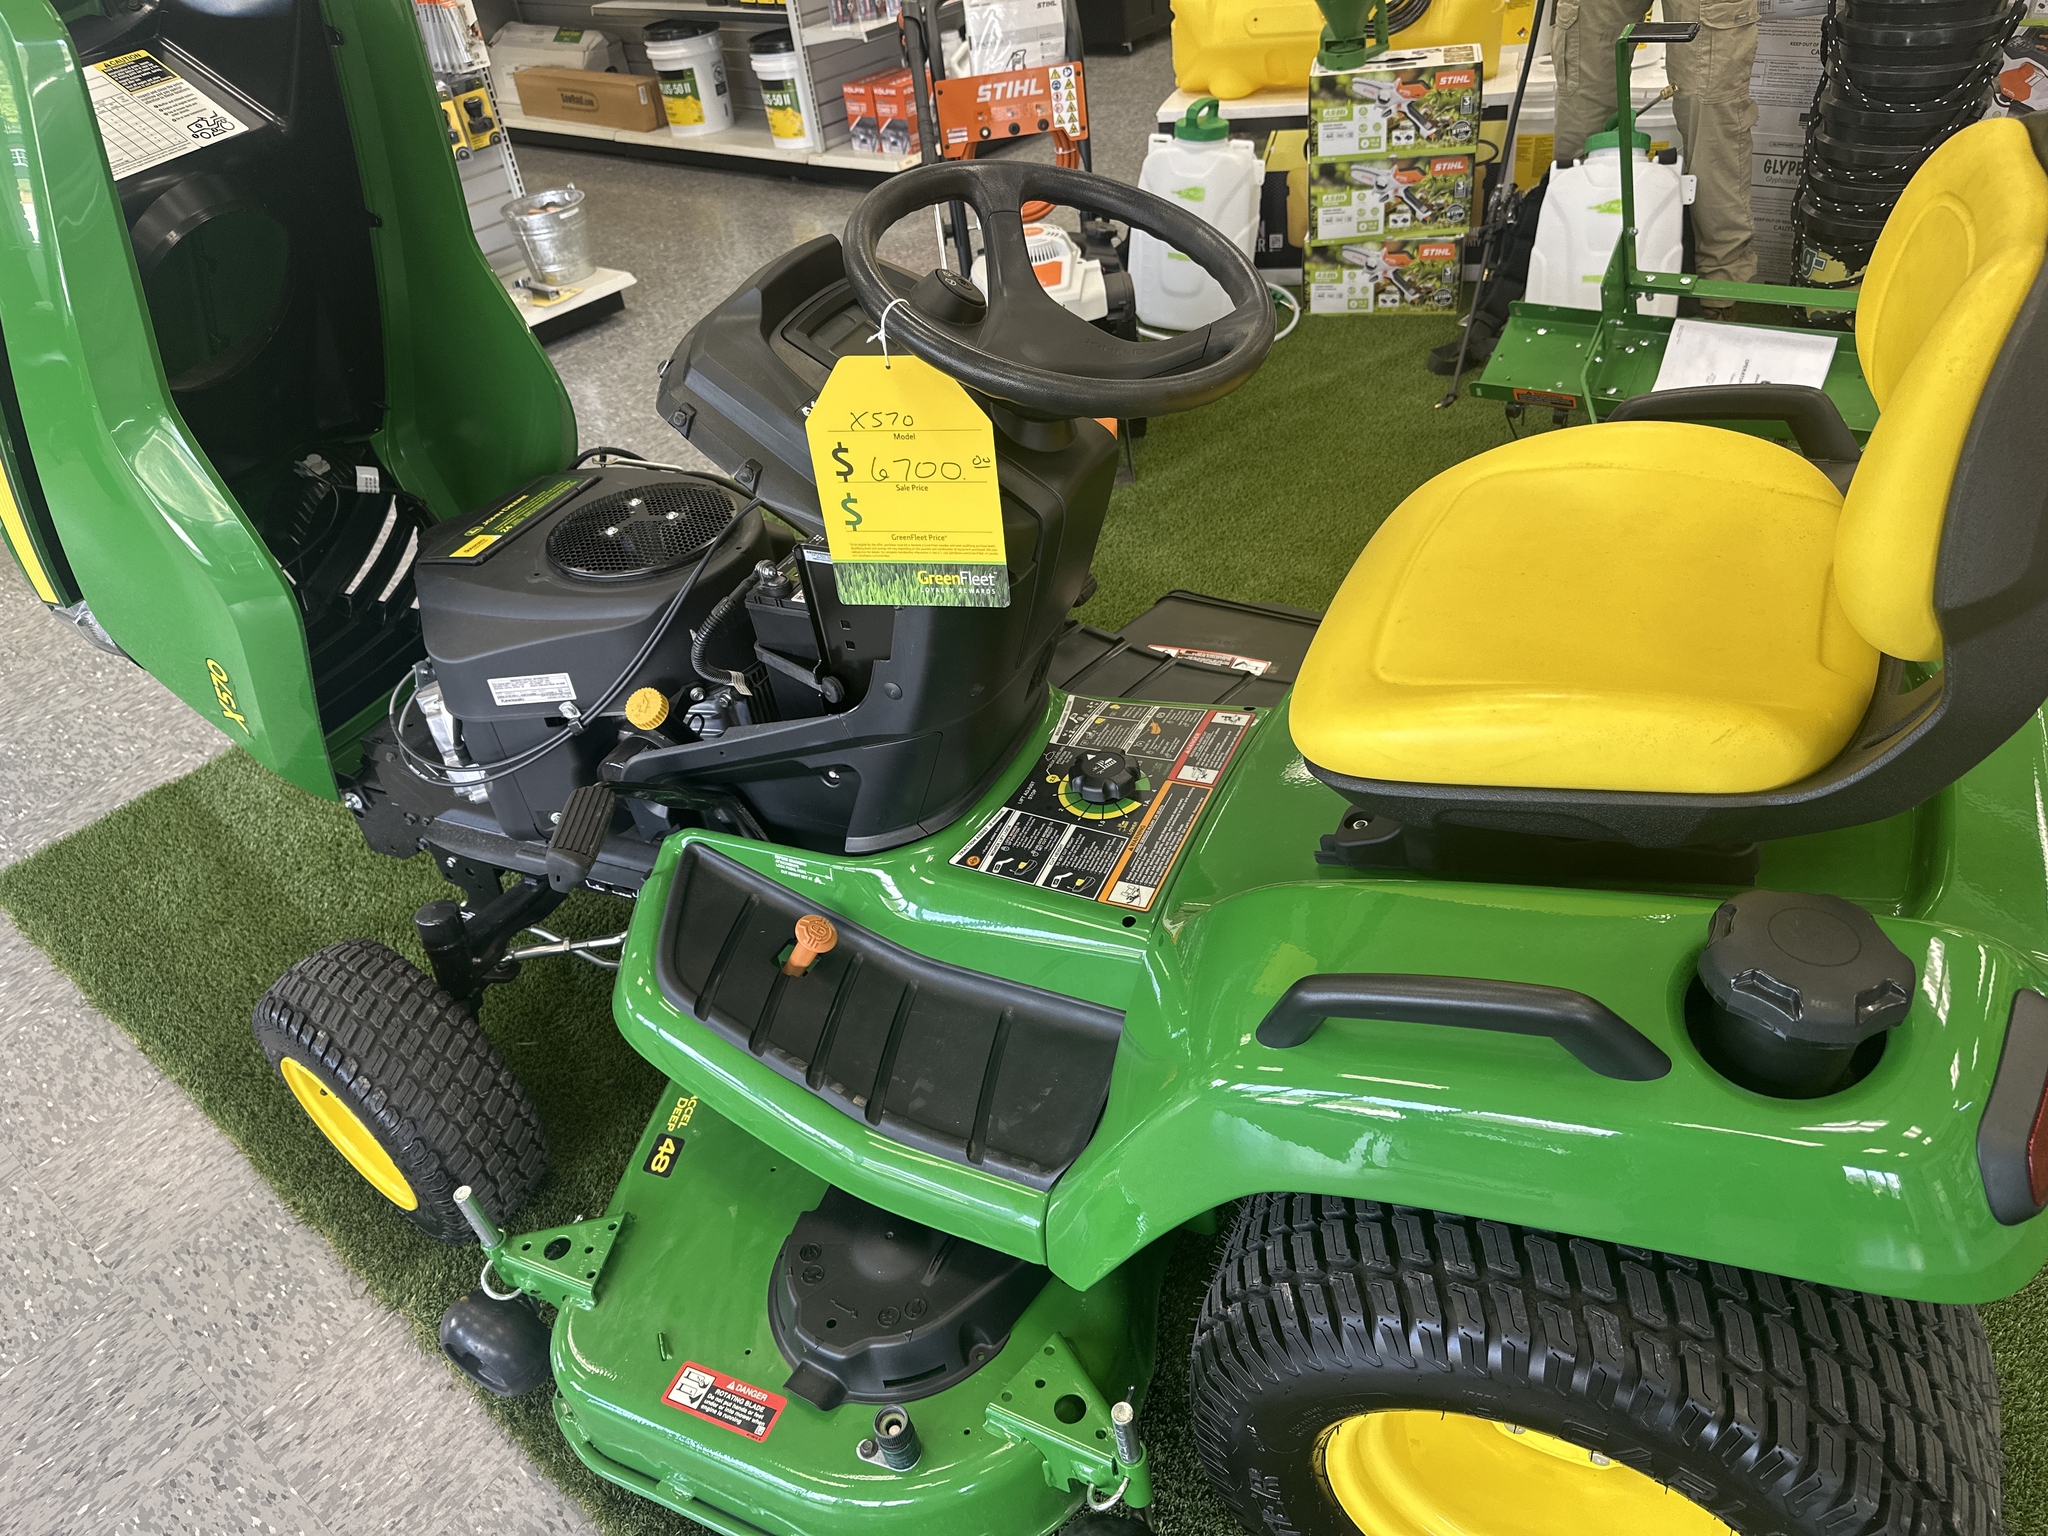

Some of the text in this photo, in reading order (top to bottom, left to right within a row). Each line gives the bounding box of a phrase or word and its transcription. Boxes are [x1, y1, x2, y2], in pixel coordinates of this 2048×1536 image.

[1037, 1, 1057, 9] STIHL
[109, 53, 141, 66] CAUTION
[977, 78, 1044, 103] STIHL
[1439, 75, 1470, 86] STIHL
[1434, 161, 1464, 172] STIHL
[1422, 248, 1451, 257] STIHL
[850, 411, 914, 431] X570
[831, 441, 854, 483] $
[895, 484, 929, 492] Sale Price
[840, 492, 863, 531] $
[206, 658, 250, 735] X570
[1016, 781, 1036, 804] LIFT ADJUST
[1027, 789, 1038, 799] STOP
[958, 838, 977, 855] TRACTION
[975, 827, 989, 838] ASSIST
[1129, 824, 1145, 846] WARNING
[988, 842, 1000, 856] MOWER
[667, 1097, 689, 1132] DEEP
[651, 1138, 676, 1173] 48
[715, 1388, 766, 1413] ROTATING BLADE
[735, 1384, 768, 1402] DANGER
[700, 1404, 718, 1415] engine
[723, 1412, 742, 1425] running
[704, 1399, 718, 1408] under
[725, 1406, 734, 1414] into
[734, 1410, 751, 1421] mower
[751, 1417, 766, 1427] when
[724, 1399, 732, 1408] put
[733, 1402, 747, 1414] hands
[754, 1411, 764, 1420] feet
